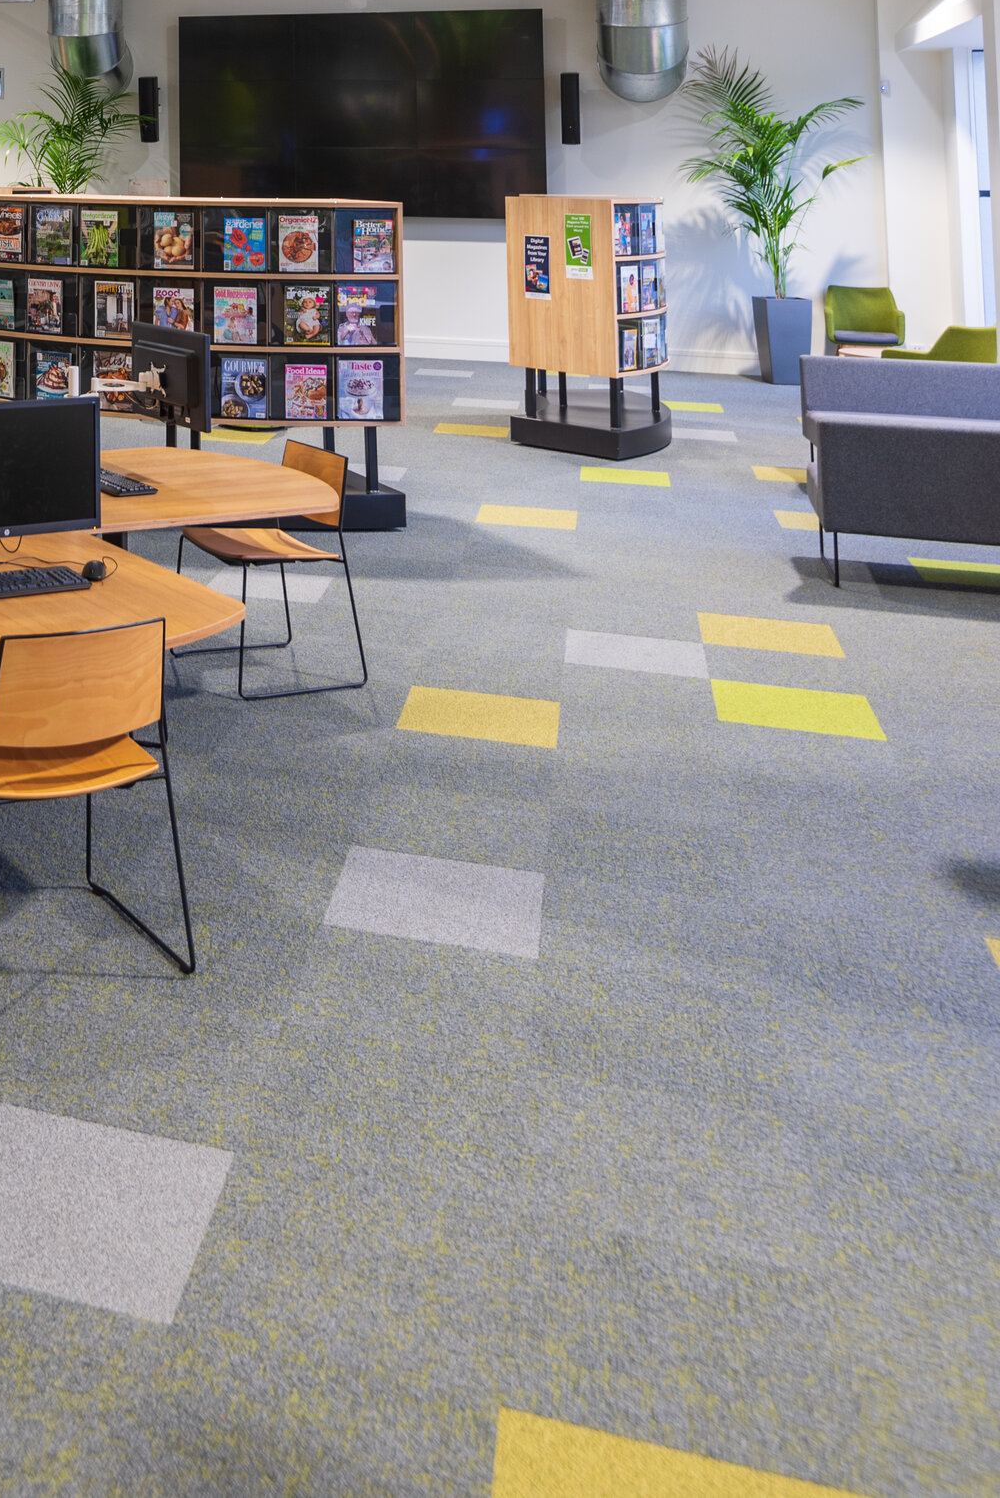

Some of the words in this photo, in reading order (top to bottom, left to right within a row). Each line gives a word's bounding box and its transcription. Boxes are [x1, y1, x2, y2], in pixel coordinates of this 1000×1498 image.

[226, 220, 264, 229] gardener
[355, 220, 381, 228] Better
[155, 288, 181, 298] good
[287, 287, 327, 299] Treasures
[359, 317, 376, 326] KNIFE
[41, 353, 69, 362] elicious
[287, 366, 304, 374] Food
[350, 361, 372, 370] Taste
